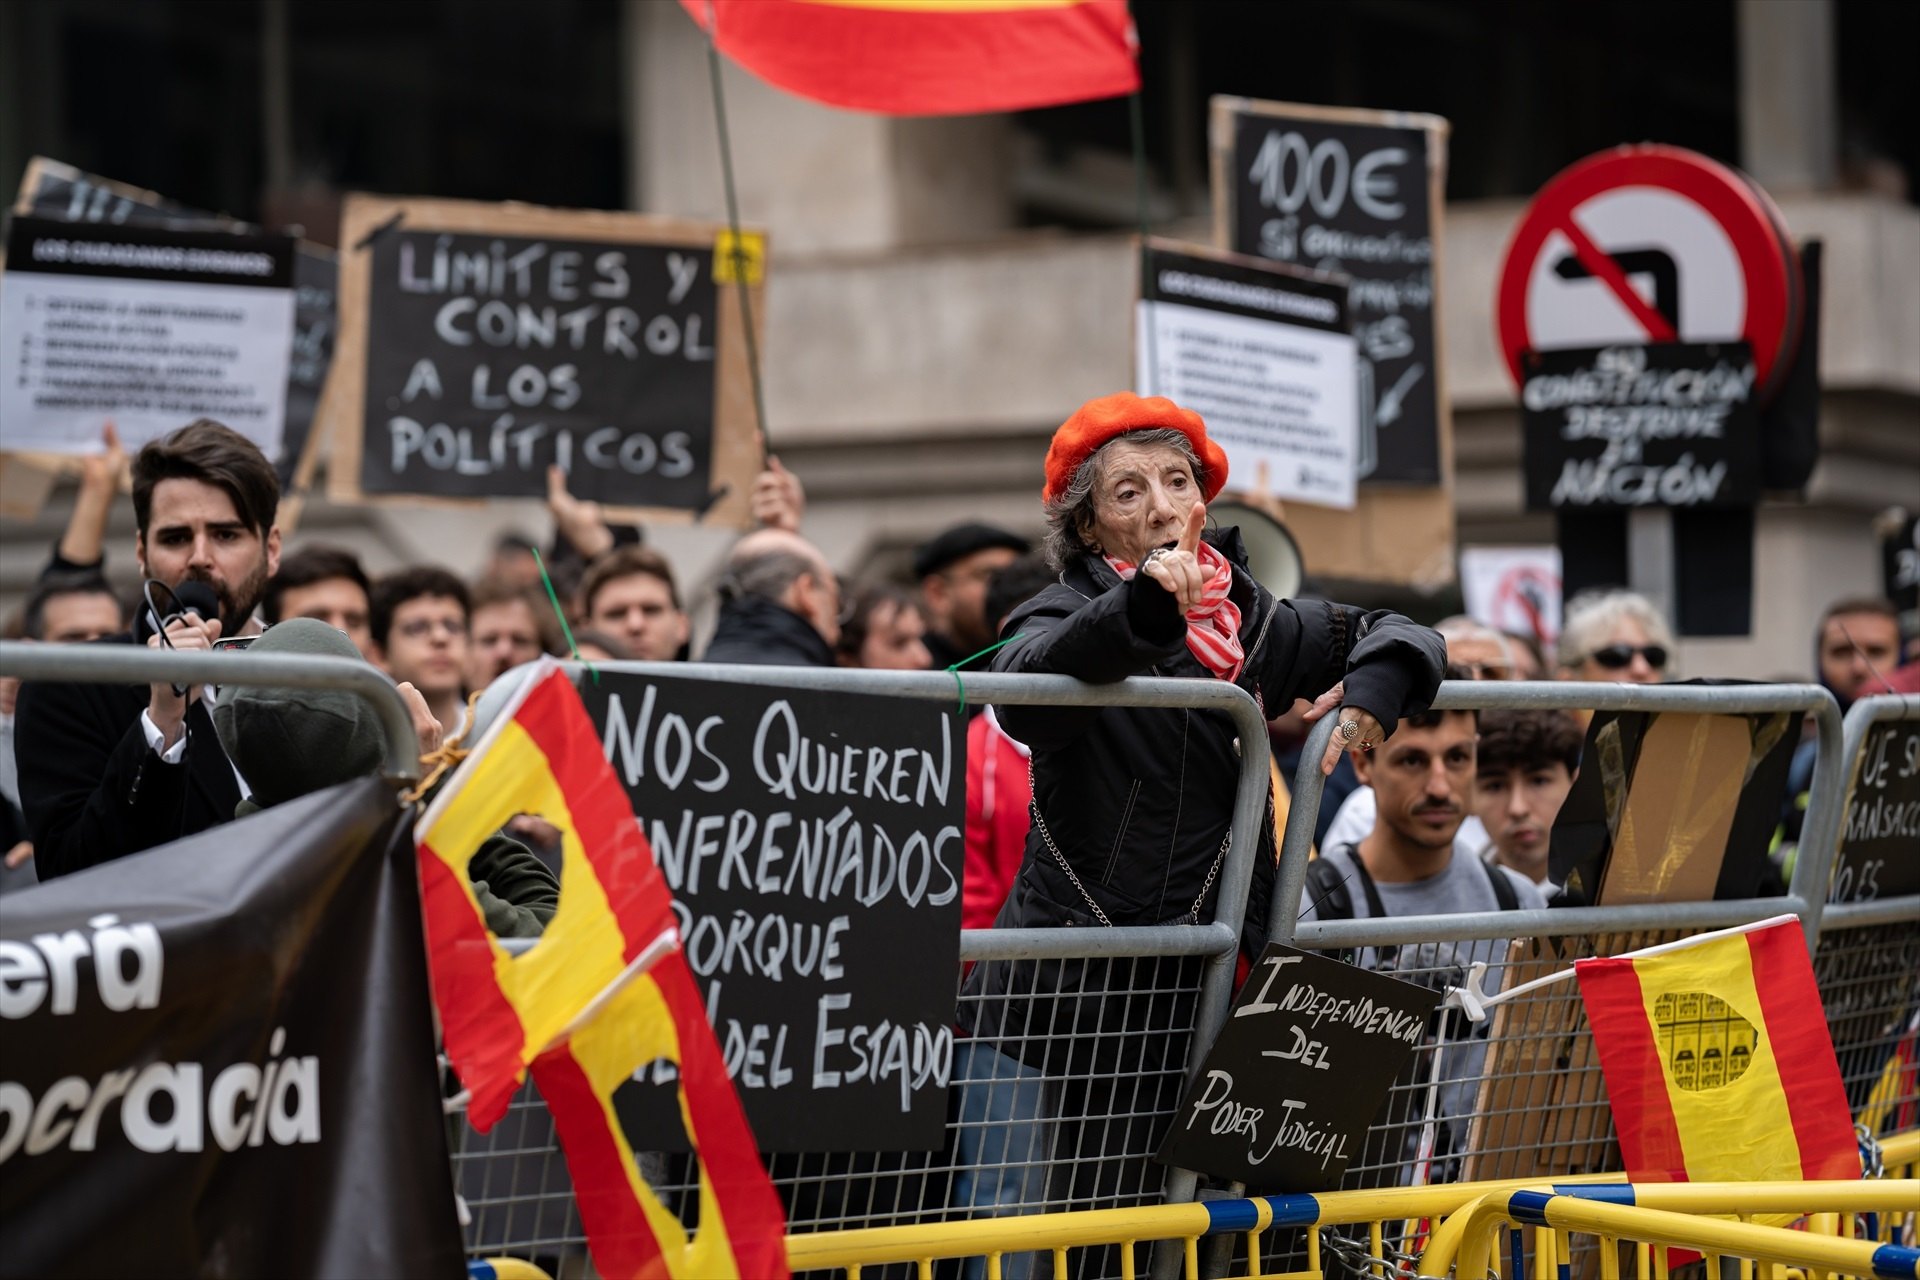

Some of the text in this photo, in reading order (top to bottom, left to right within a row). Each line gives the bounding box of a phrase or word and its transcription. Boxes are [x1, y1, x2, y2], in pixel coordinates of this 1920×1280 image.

[1249, 130, 1409, 220] 100€
[665, 251, 698, 304] Y
[435, 297, 715, 361] CONTROL
[402, 358, 581, 410] A LOS
[388, 413, 695, 478] POLÍTICOS
[1551, 452, 1727, 505] NACIÓN
[603, 684, 951, 807] NOS QUIEREN
[636, 806, 961, 908] NFRENTADOS
[1234, 956, 1424, 1044] INDEPENDENCIA
[722, 1019, 793, 1089] DEL
[812, 992, 954, 1112] ESTADO
[1262, 1024, 1331, 1070] DEL
[1187, 1070, 1348, 1170] PODER JUDICIAL
